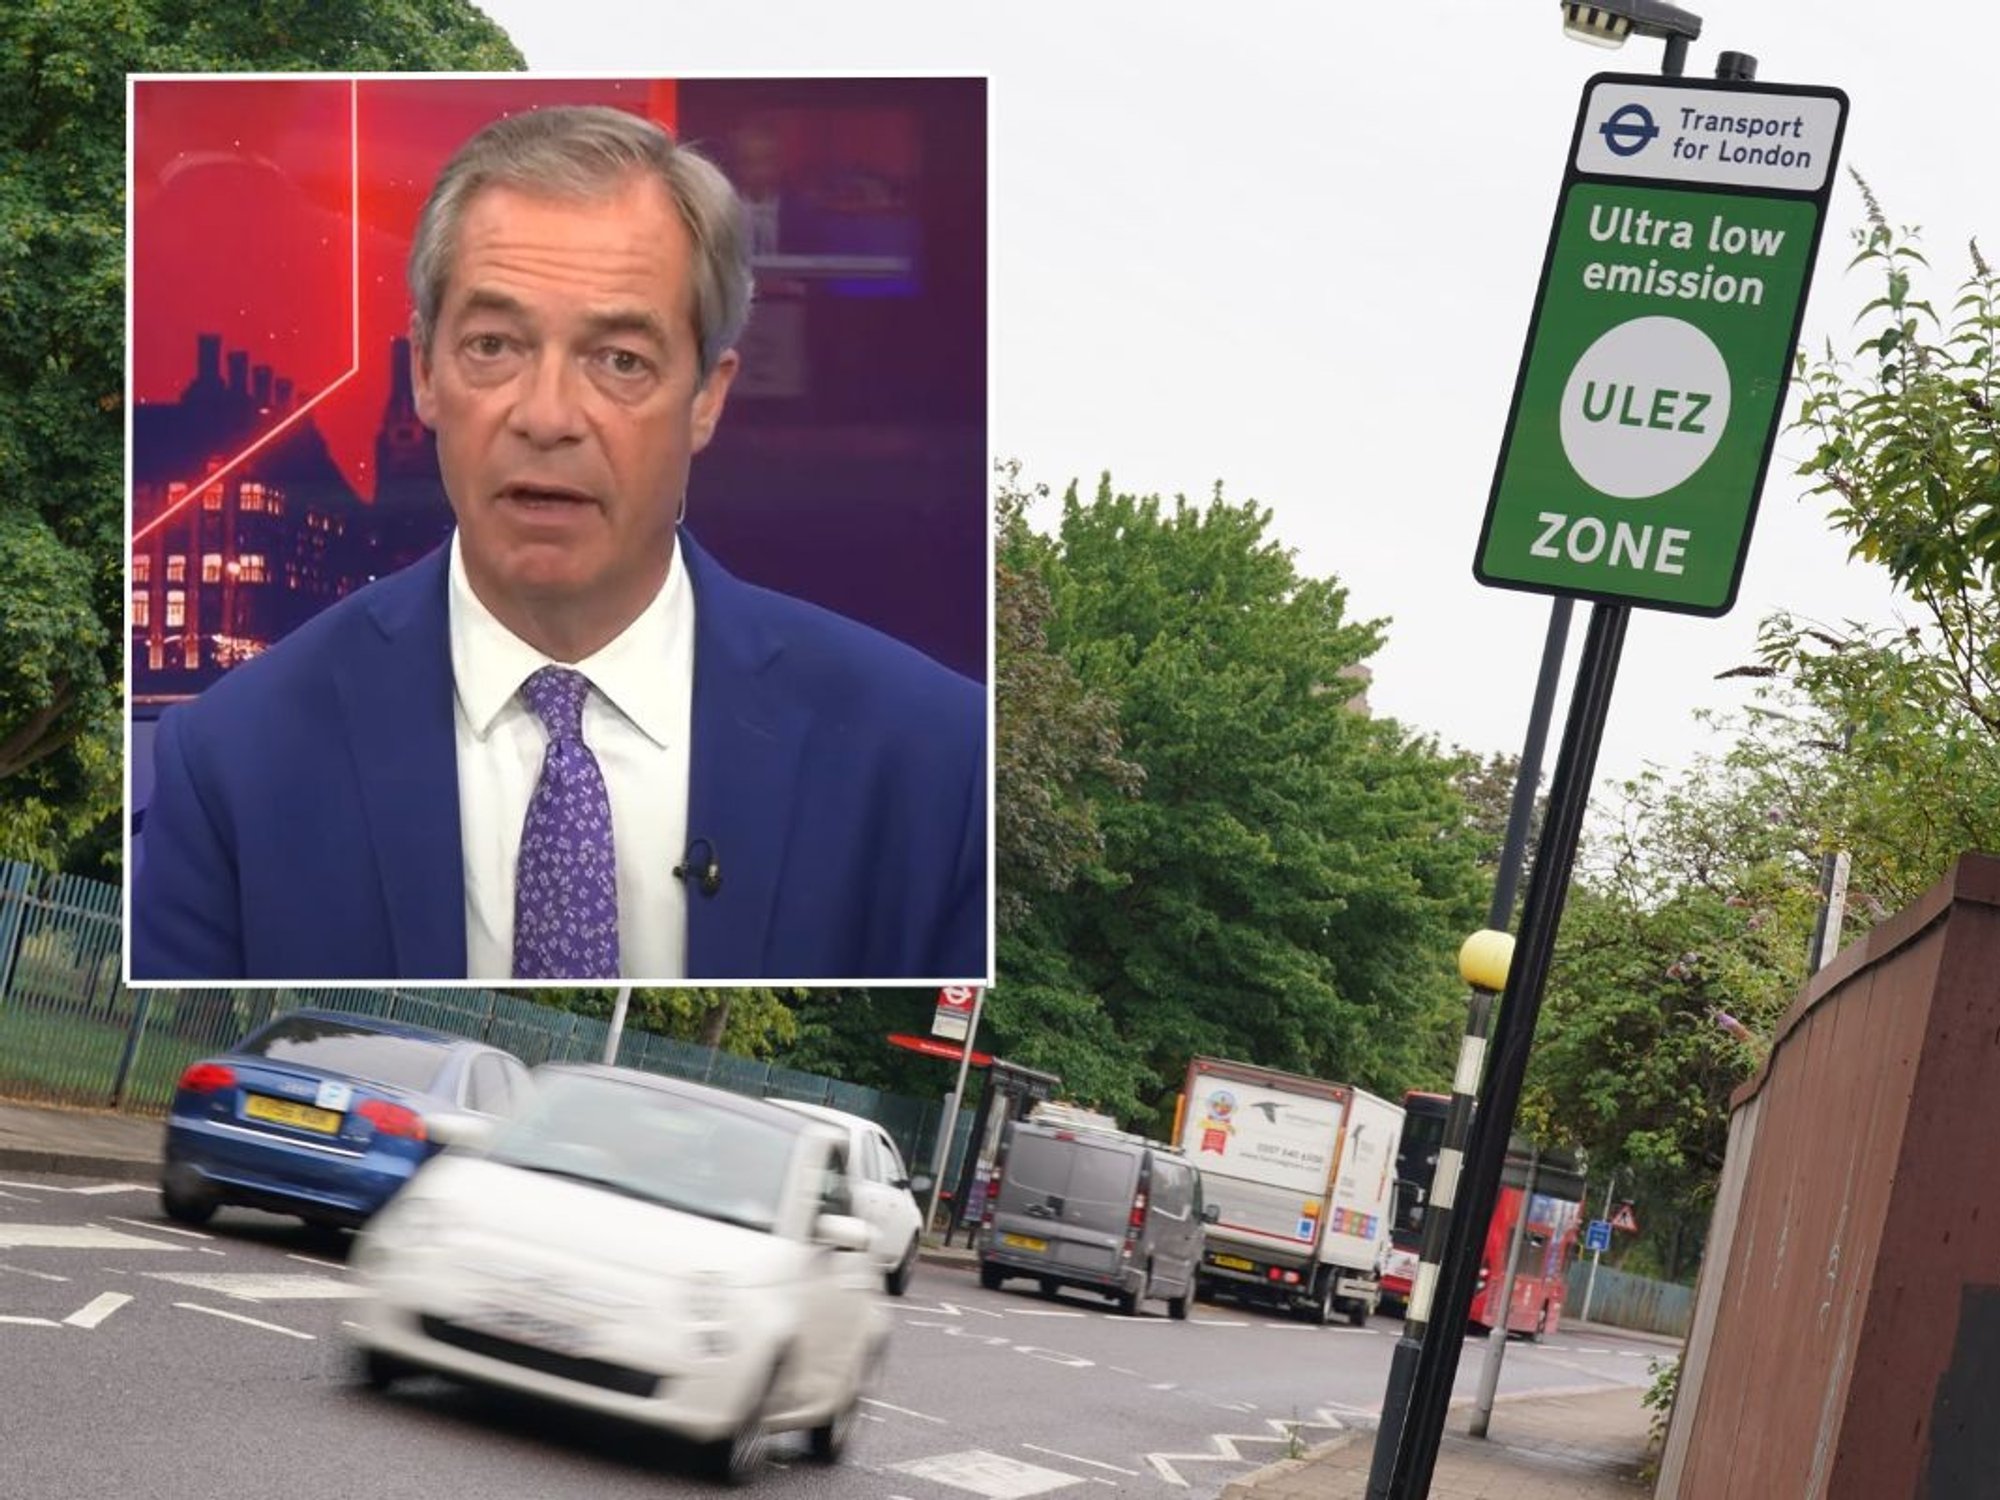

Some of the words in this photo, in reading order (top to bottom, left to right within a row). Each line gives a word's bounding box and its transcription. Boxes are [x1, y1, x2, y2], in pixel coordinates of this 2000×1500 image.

[1680, 107, 1804, 139] Transport
[1672, 137, 1709, 161] for
[1718, 140, 1812, 169] London
[1588, 204, 1694, 250] Ultra
[1708, 215, 1786, 257] low
[1583, 258, 1765, 306] emission
[1581, 380, 1713, 435] ULEZ
[1529, 511, 1692, 576] ZONE
